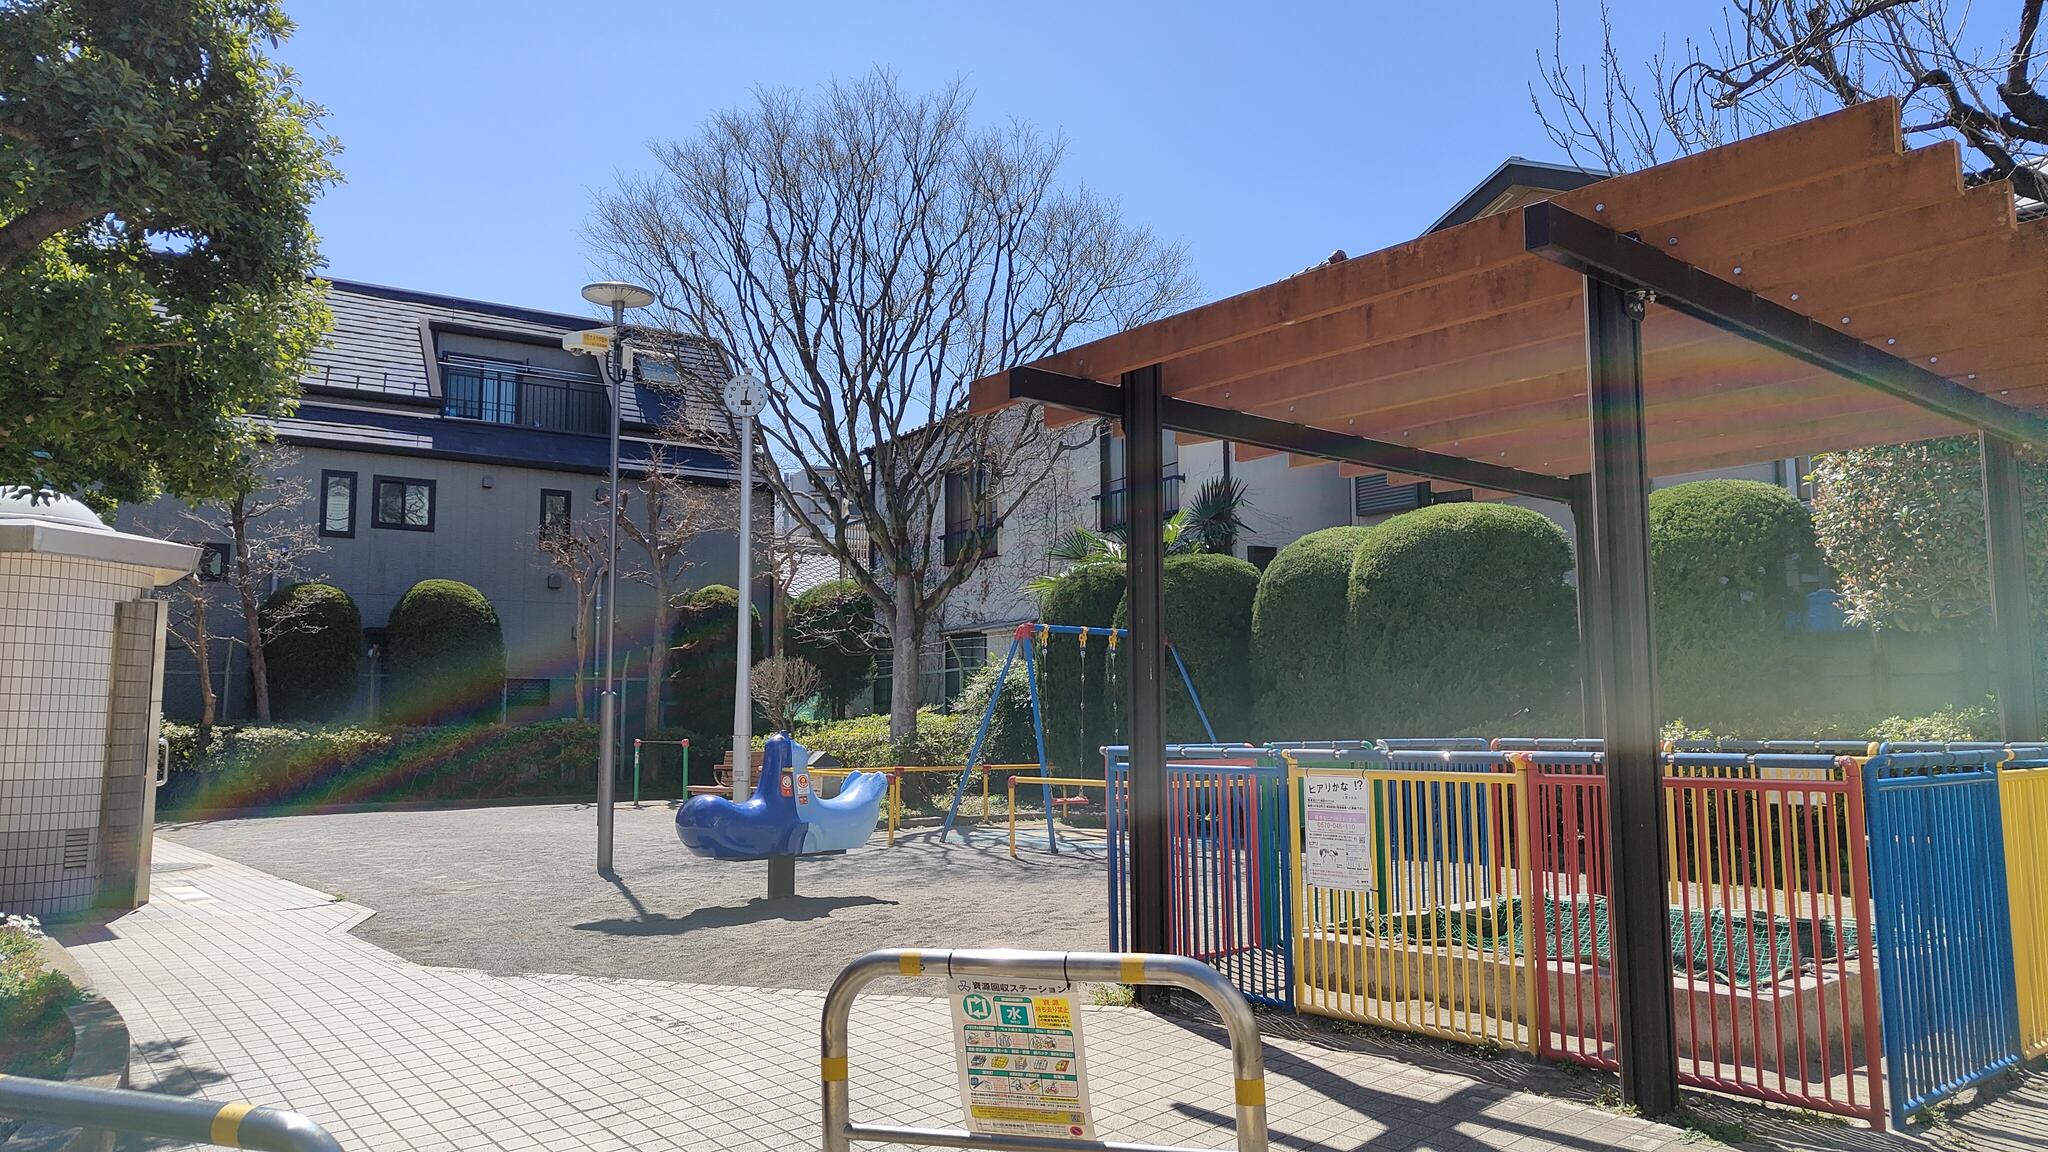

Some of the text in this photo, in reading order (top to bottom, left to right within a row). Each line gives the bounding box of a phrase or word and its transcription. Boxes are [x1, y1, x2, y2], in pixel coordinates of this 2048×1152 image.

[1308, 782, 1349, 794] ヒアリかな
[972, 981, 1067, 993] 資源回収ステーション
[1006, 1006, 1022, 1020] 水
